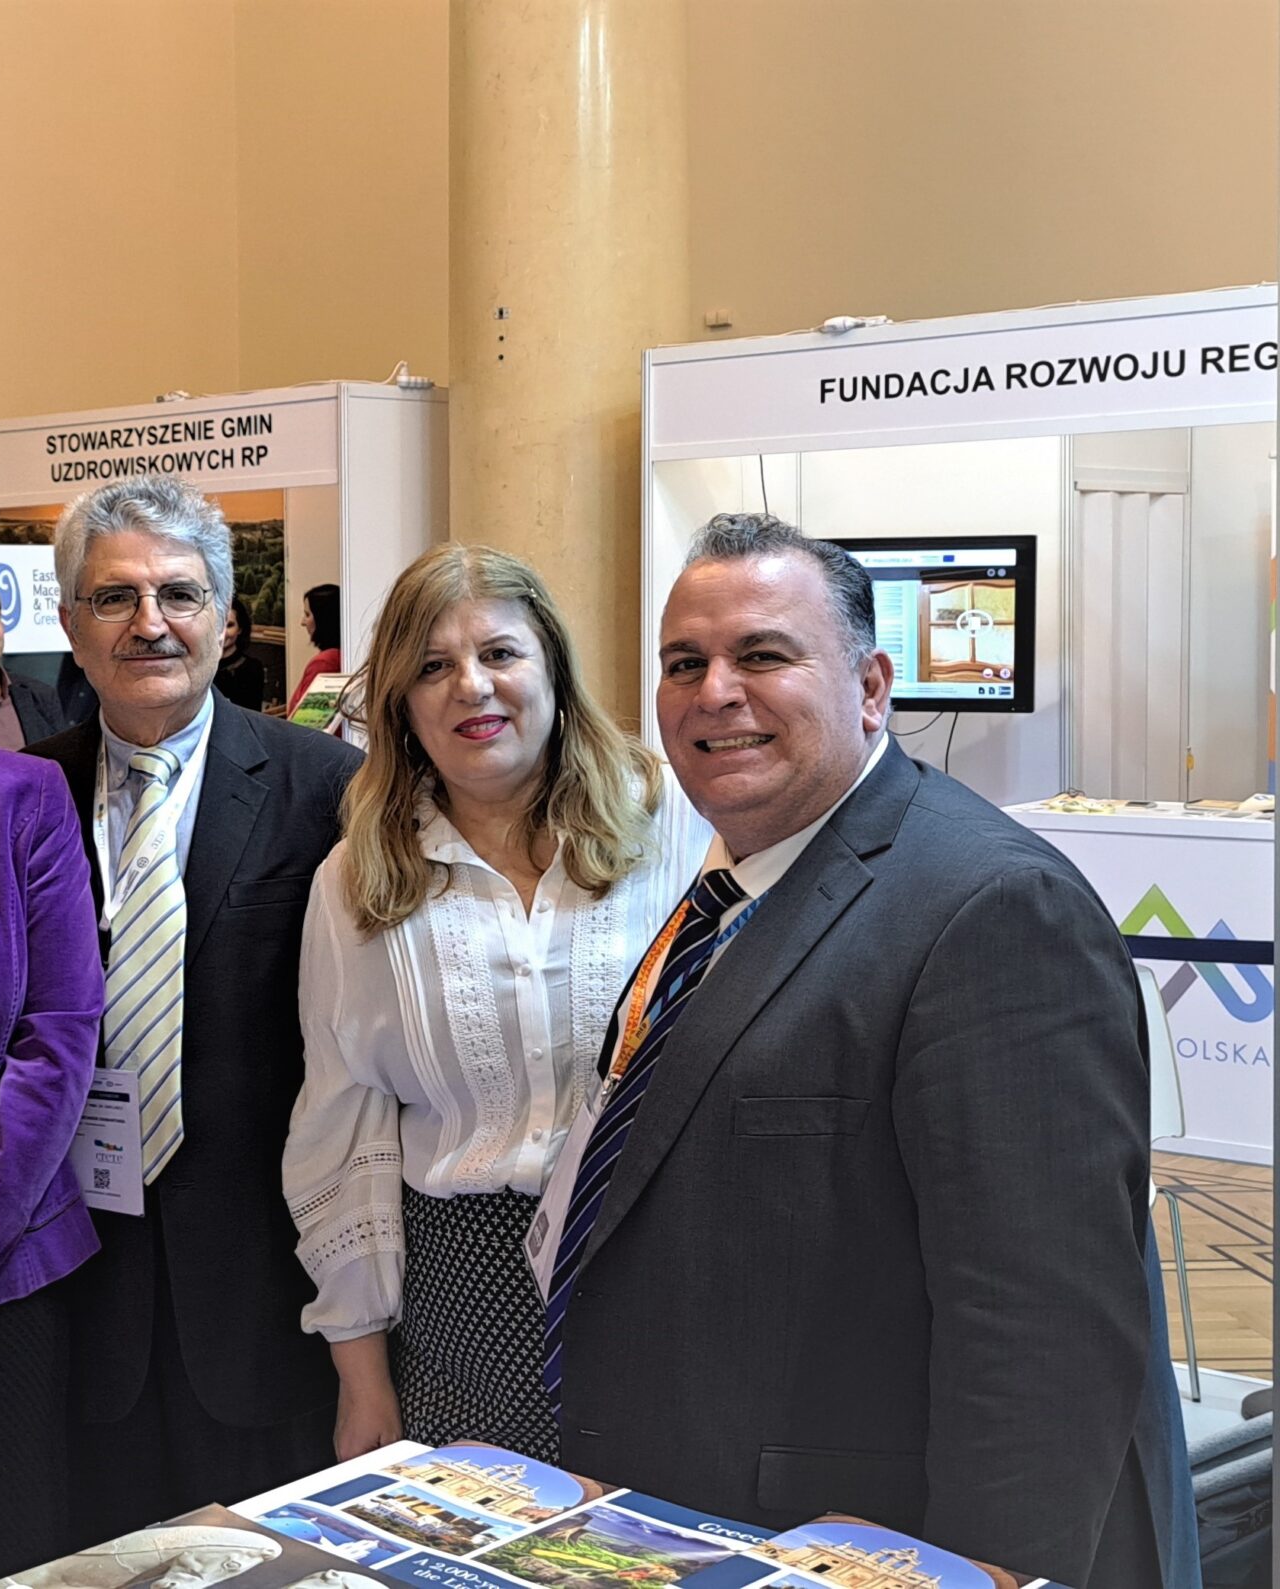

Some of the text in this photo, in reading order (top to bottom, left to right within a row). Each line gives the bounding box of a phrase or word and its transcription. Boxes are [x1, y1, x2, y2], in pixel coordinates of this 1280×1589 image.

[820, 341, 1278, 403] FUNDACJA ROZWOJU REG
[46, 413, 273, 454] STOWARZYSZENIE GMIN
[51, 445, 268, 482] UZDROWISKOWYCH RP
[33, 598, 41, 610] &
[1176, 1037, 1270, 1067] OLSKA
[412, 1558, 429, 1566] A
[413, 1569, 441, 1581] the
